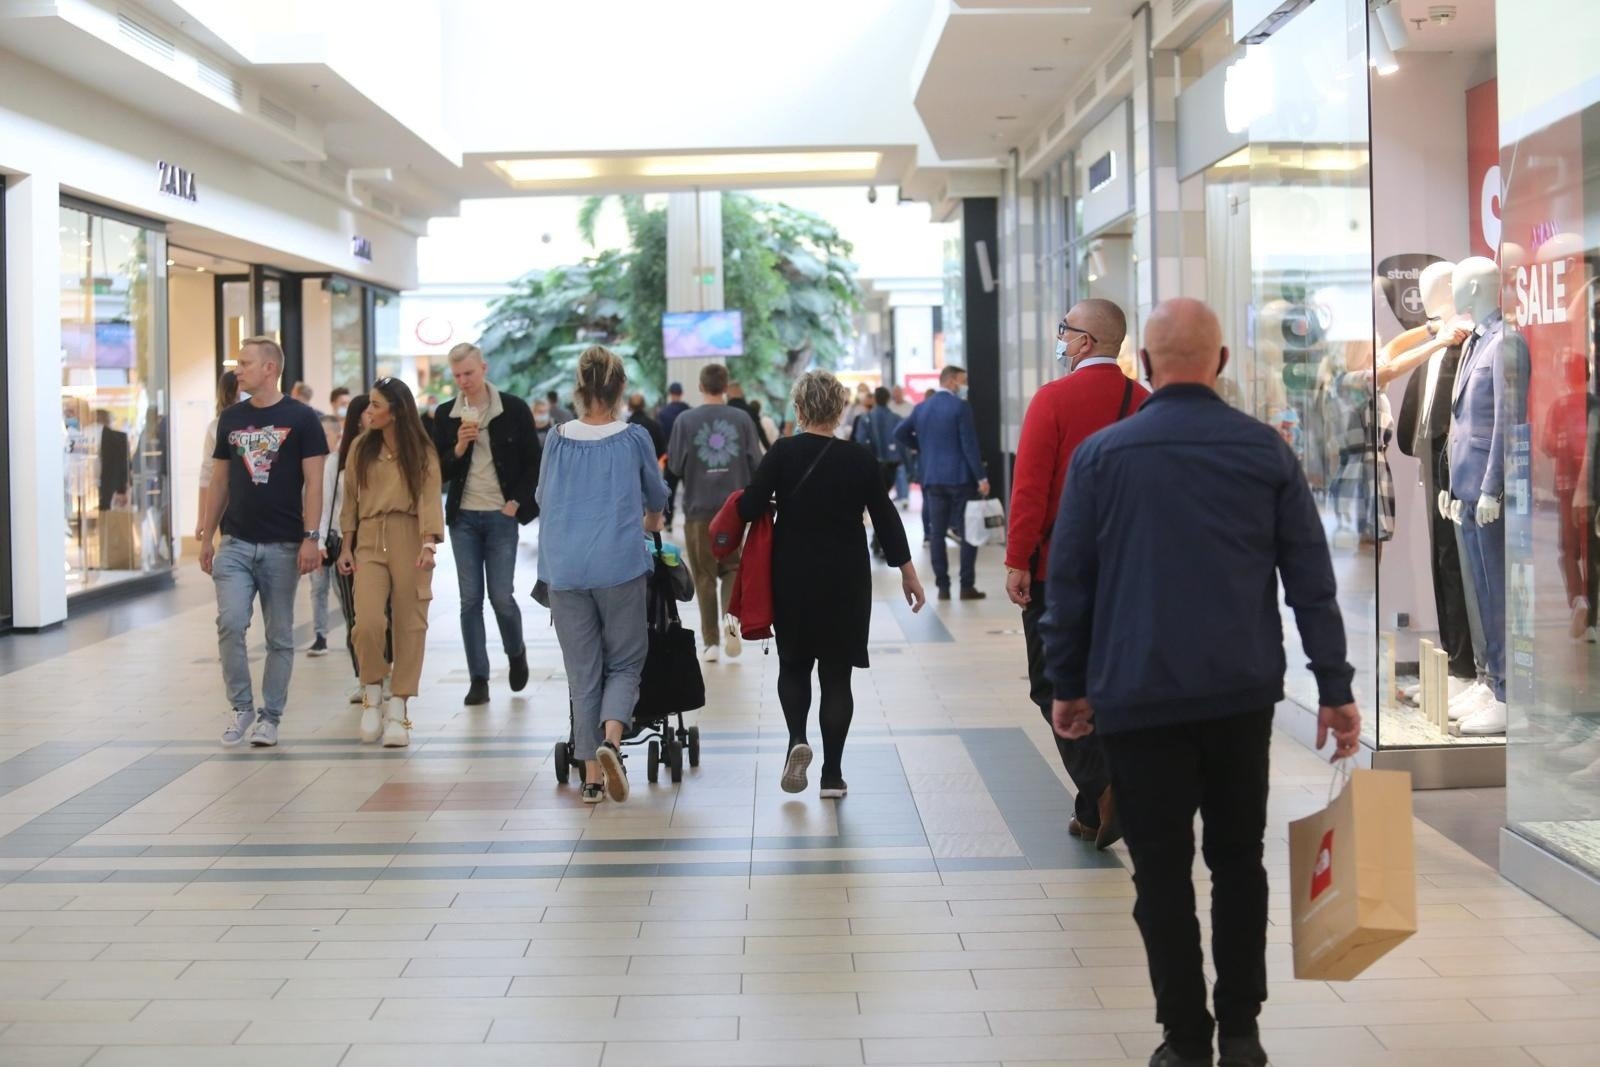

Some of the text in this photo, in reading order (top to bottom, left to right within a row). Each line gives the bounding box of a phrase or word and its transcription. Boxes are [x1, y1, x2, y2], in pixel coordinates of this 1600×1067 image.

[157, 160, 197, 202] ZARA
[1388, 268, 1420, 280] strell
[1516, 260, 1567, 327] SALE
